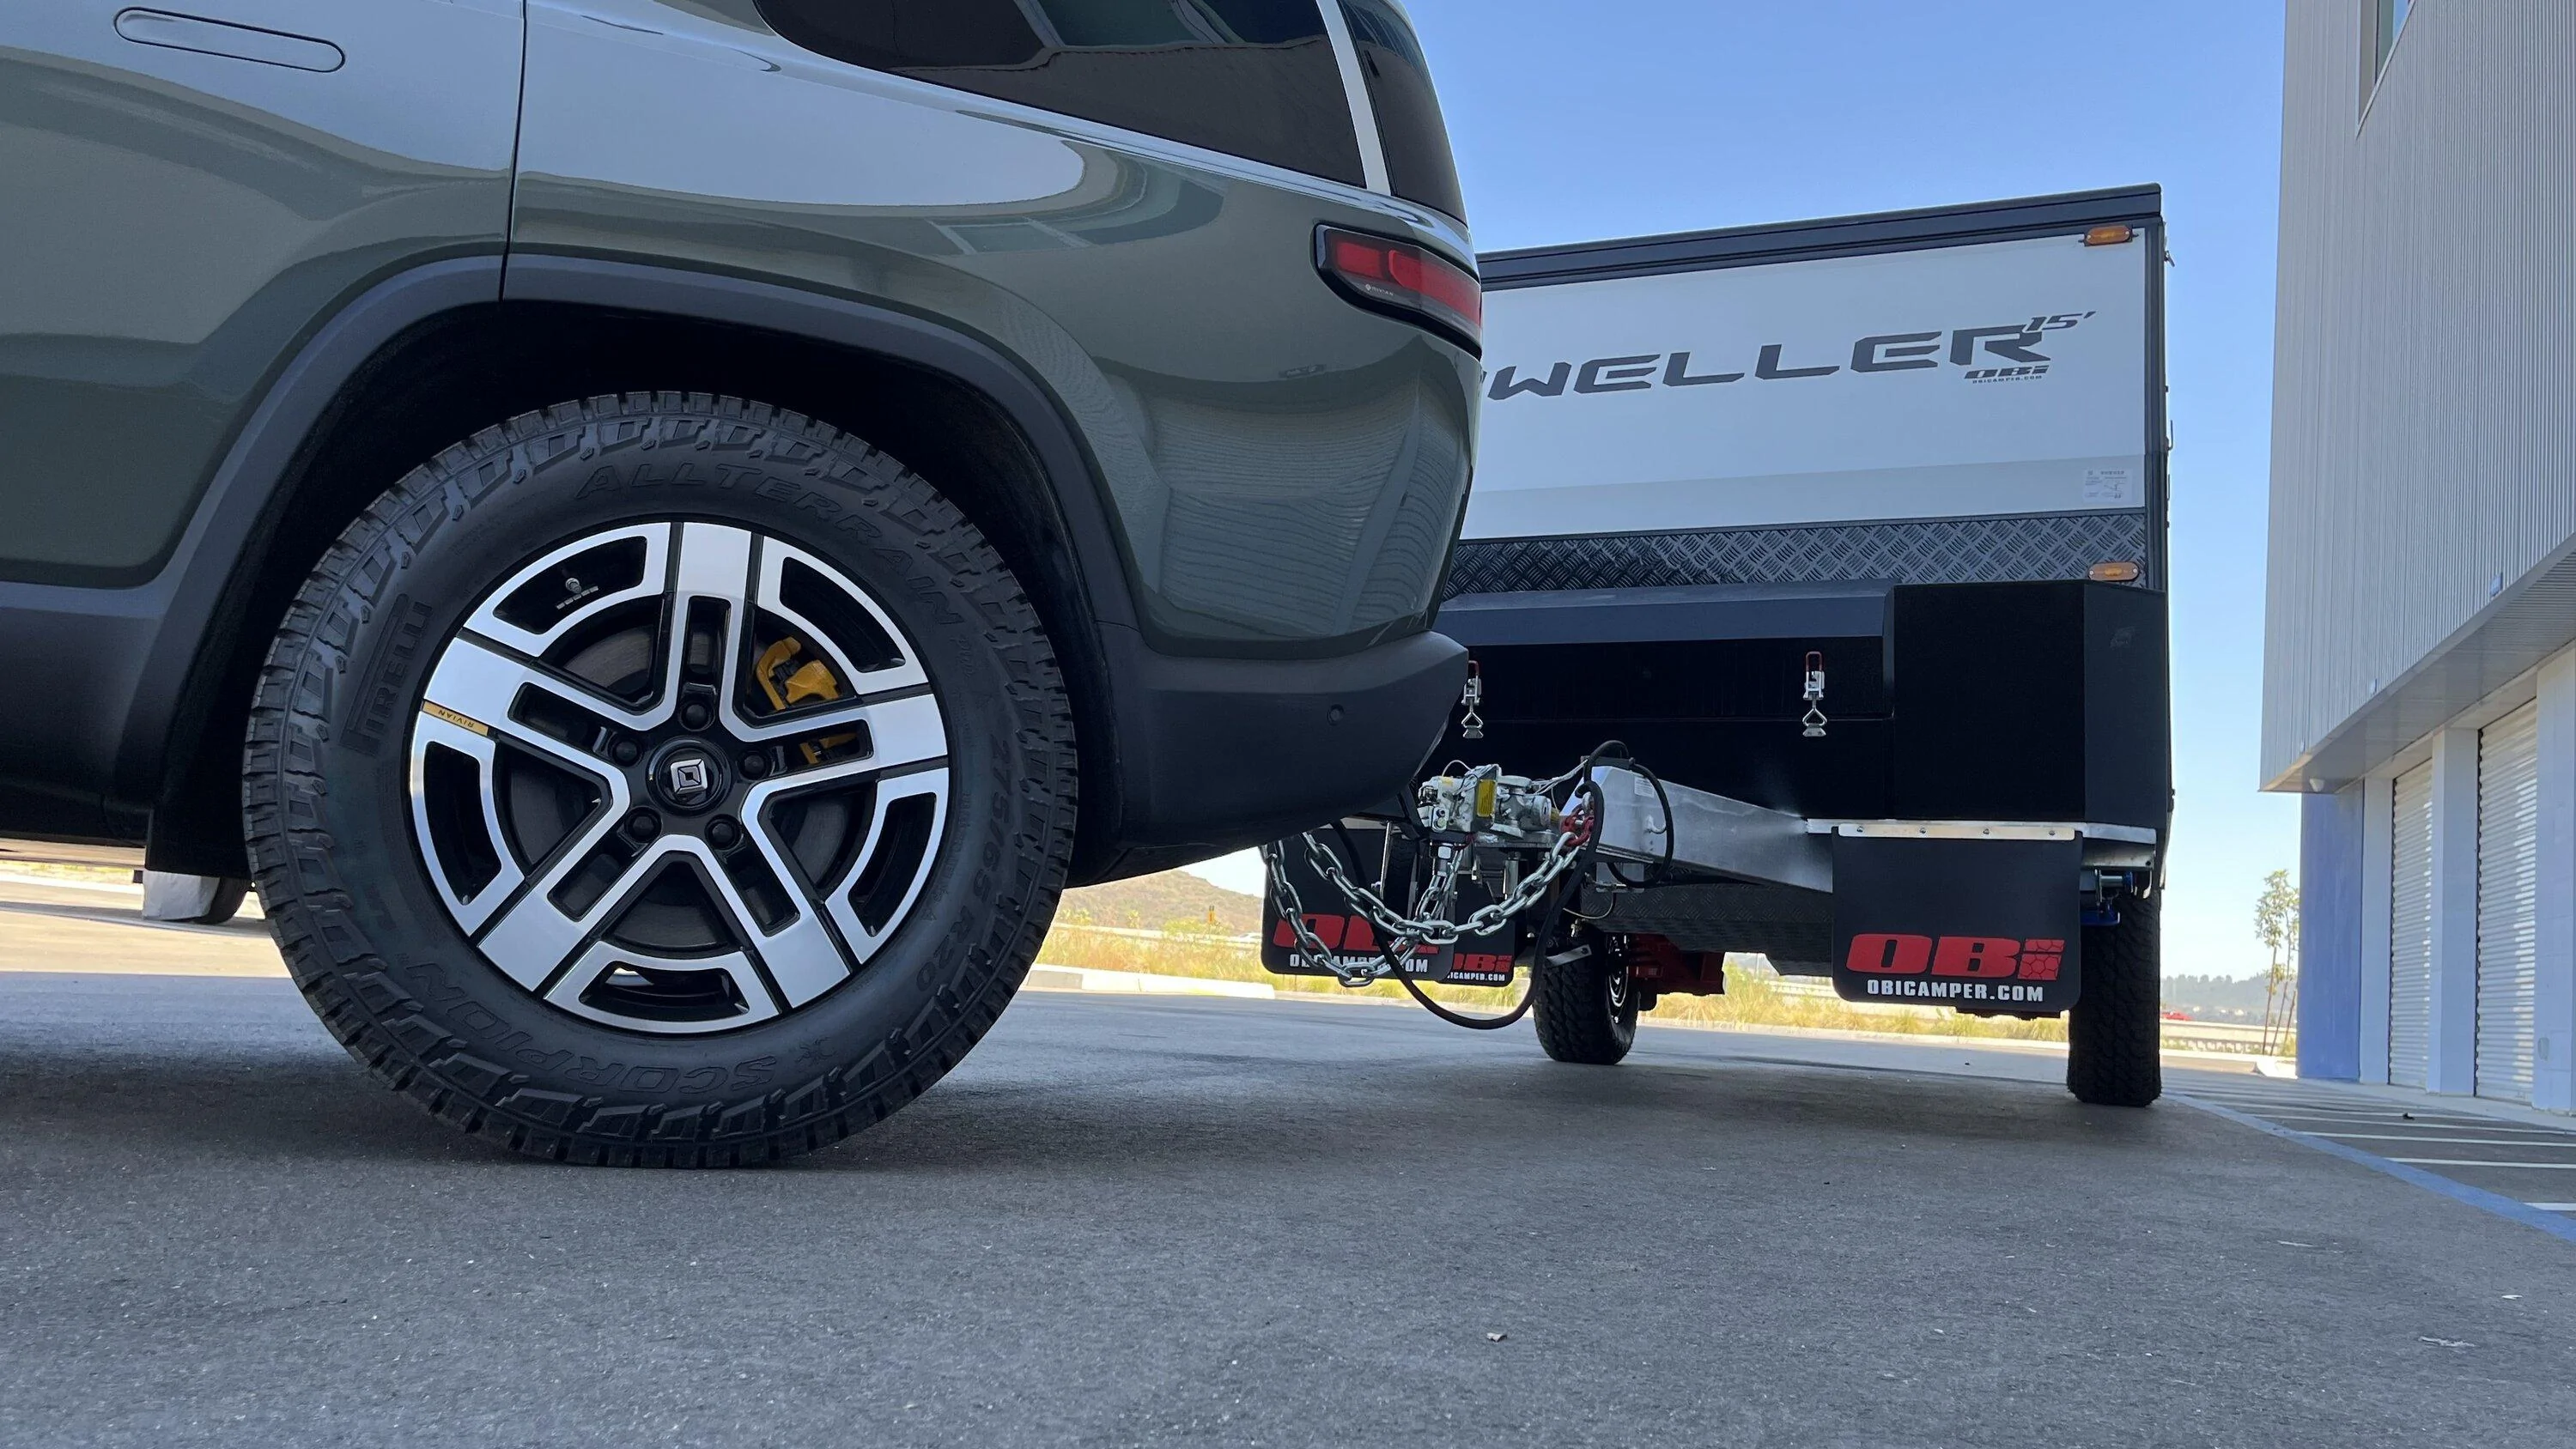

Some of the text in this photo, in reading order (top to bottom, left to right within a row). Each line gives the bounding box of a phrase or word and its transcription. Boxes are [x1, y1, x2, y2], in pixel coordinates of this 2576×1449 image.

[1482, 324, 2051, 401] WELLER
[438, 709, 475, 728] RIVIAN
[1868, 979, 2043, 1002] OBICAMPER.COM
[404, 961, 776, 1094] SCORPION
